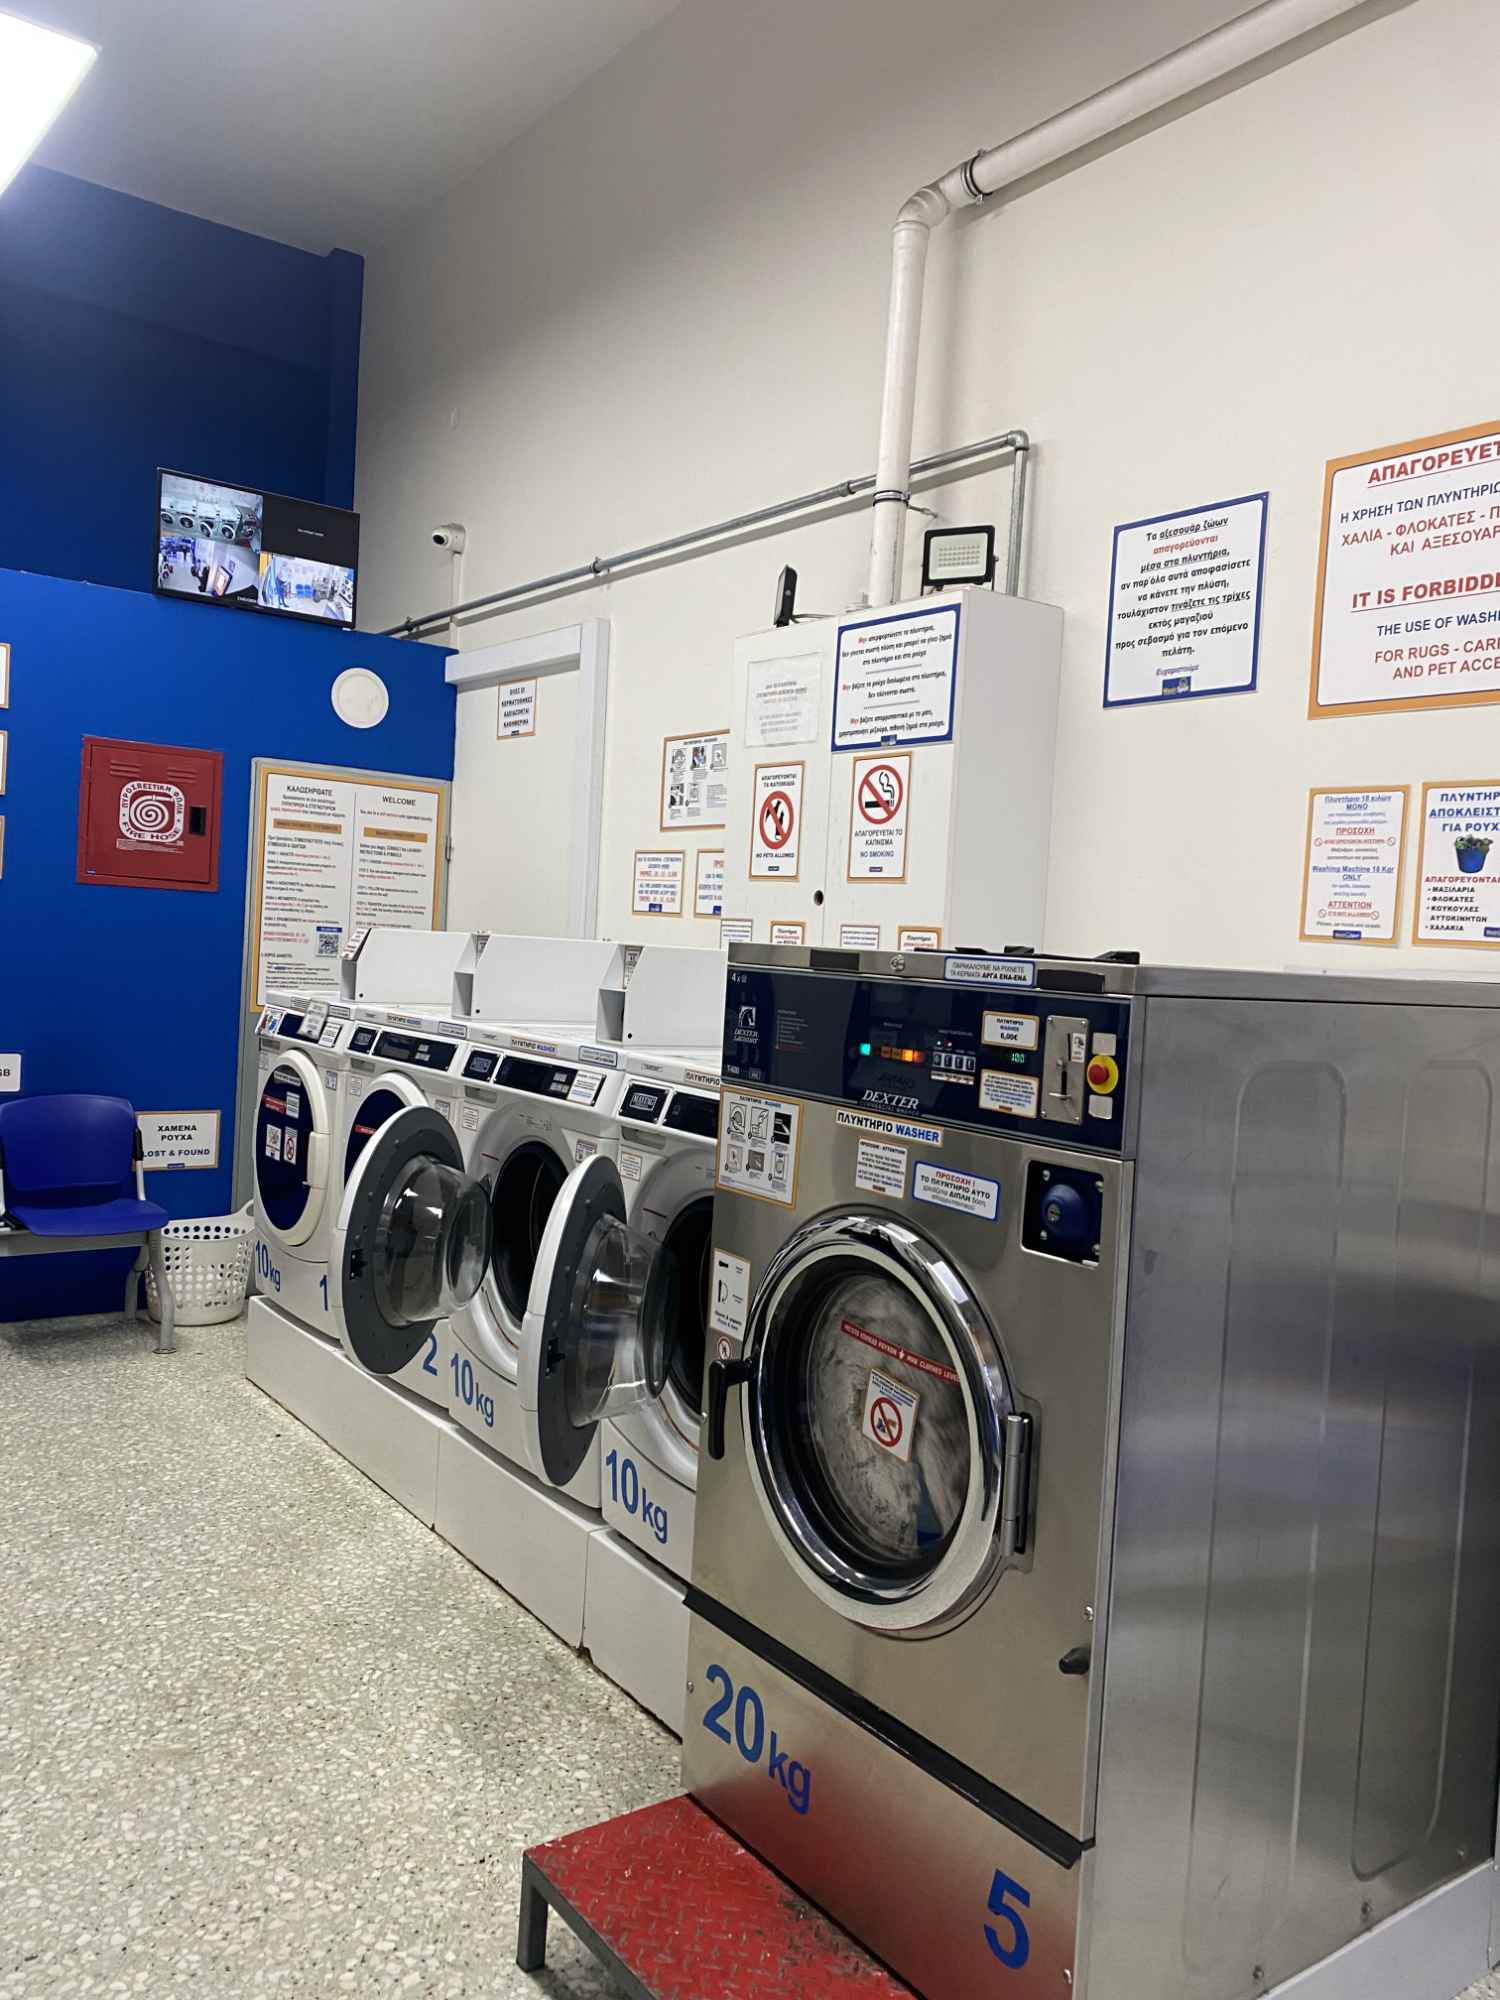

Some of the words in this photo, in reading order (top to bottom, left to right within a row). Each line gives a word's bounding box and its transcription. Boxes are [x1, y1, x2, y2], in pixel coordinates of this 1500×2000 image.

[1340, 513, 1348, 523] Η
[1352, 503, 1393, 521] ΧΡΗΣΗ
[1397, 497, 1423, 512] ΤΩΝ
[1146, 533, 1157, 541] Τα
[1342, 528, 1383, 546] ΧΑΛΙΑ
[1396, 510, 1476, 536] ΦΛΟΚΑΤΕΣ
[1153, 535, 1218, 554] απαγορεύονται
[1390, 541, 1414, 555] ΚΑΙ
[1422, 525, 1500, 550] ΑΞΕΣΟΥΑΡ
[1140, 561, 1162, 573] μέσα
[1164, 558, 1179, 567] στα
[1168, 571, 1188, 581] αυτά
[1191, 559, 1251, 577] αποφασίσετε
[1150, 587, 1178, 599] κάνετε
[1180, 585, 1195, 595] την
[1352, 592, 1371, 608] IT
[1377, 588, 1395, 605] IS
[1117, 604, 1168, 620] τουλάχιστον
[1171, 598, 1205, 612] τινάζετε
[1208, 595, 1220, 605] τις
[1222, 591, 1251, 603] τρίχες
[1148, 618, 1171, 629] εκτός
[1174, 612, 1213, 627] μαγαζιού
[1376, 623, 1401, 636] THE
[1405, 619, 1431, 633] USE
[1434, 616, 1453, 629] OF
[1456, 610, 1500, 626] WASH
[1115, 639, 1135, 650] προς
[1137, 632, 1174, 647] σεβασμό
[1177, 631, 1190, 640] για
[1193, 628, 1208, 638] τον
[1210, 622, 1248, 635] επόμενο
[1375, 649, 1403, 663] FOR
[1408, 643, 1450, 659] RUGS
[1393, 665, 1423, 680] AND
[1428, 661, 1456, 676] PET
[382, 795, 416, 806] WELCOME
[1442, 823, 1461, 832] ΓΙΑ
[1465, 823, 1500, 832] ΡΟΥΧ
[869, 850, 894, 858] SMOKING
[862, 1090, 919, 1109] DEXTER
[837, 1112, 893, 1132] ΠΛΥΝΤΗΡΙΟ
[895, 1124, 940, 1142] WASHER
[178, 1148, 210, 1157] FOUND
[921, 1175, 929, 1183] ΤΟ
[931, 1178, 969, 1193] ΠΛΥΝΤΗΡΙΟ
[971, 1190, 990, 1199] ΑΥΤΟ
[936, 1171, 971, 1185] ΠΡΟΣΟΧΗ
[949, 1191, 970, 1203] ΔΙΠΛΗ
[255, 1239, 281, 1292] 10kg
[319, 1274, 329, 1311] 1
[422, 1334, 439, 1376] 2
[450, 1352, 495, 1428] 10kg
[605, 1449, 668, 1544] 10kg
[703, 1664, 811, 1815] 20kg
[983, 1868, 1031, 1969] 5
